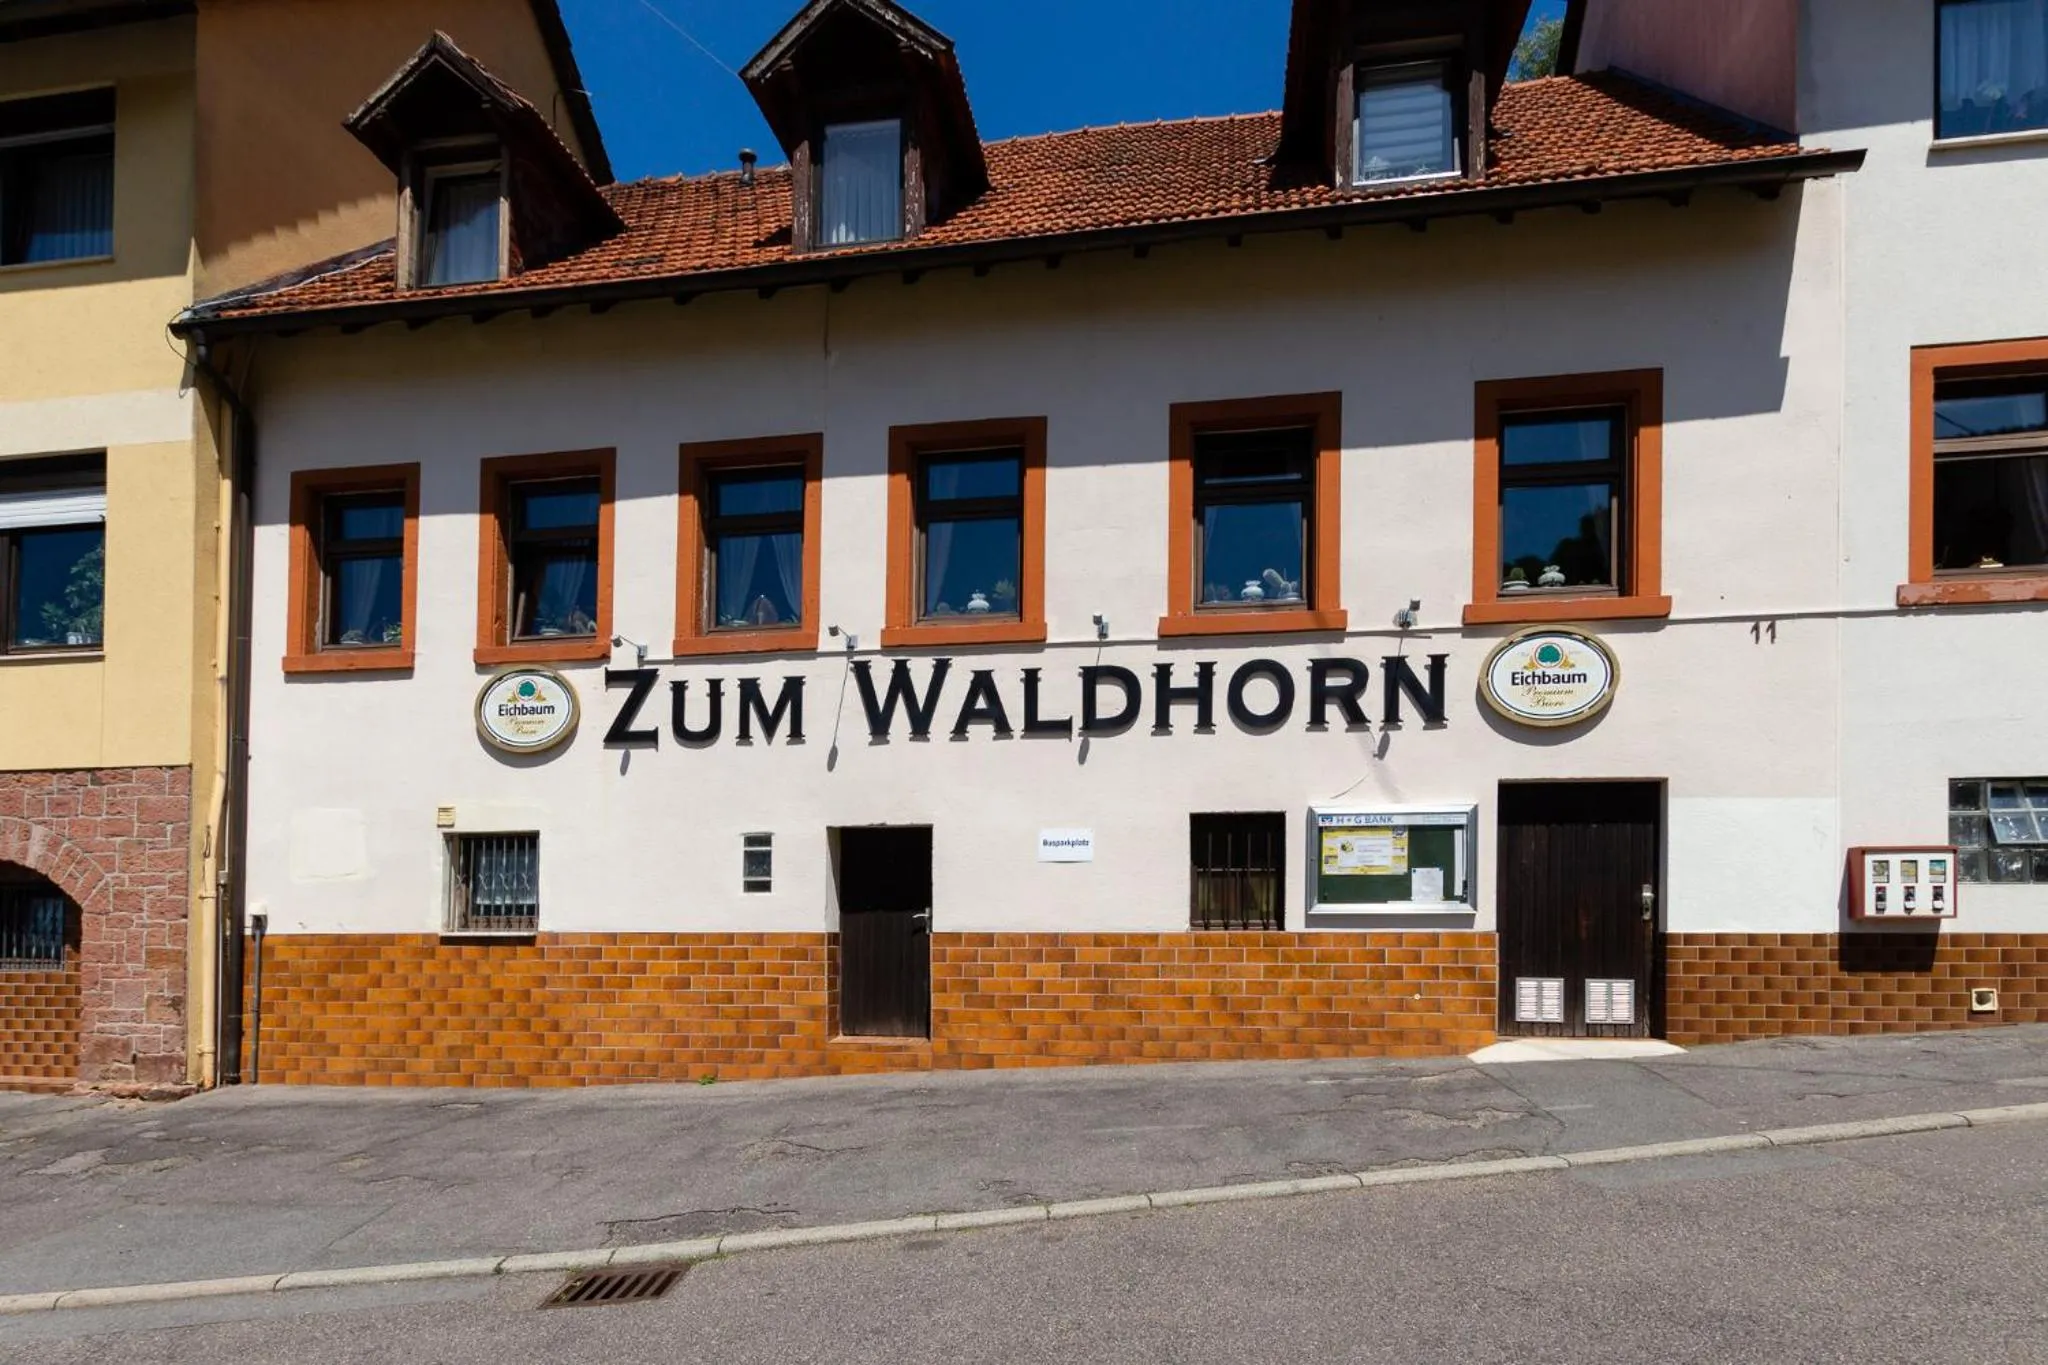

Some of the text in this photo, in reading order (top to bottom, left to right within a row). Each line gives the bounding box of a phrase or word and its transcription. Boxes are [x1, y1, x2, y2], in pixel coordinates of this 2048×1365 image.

[1750, 620, 1776, 645] 11
[1511, 671, 1587, 686] Eichbaum
[604, 653, 1450, 745] ZUM WALDHORN
[498, 703, 555, 716] Eichbaum
[1365, 815, 1394, 823] BANK
[1042, 837, 1090, 848] Busparkplatz
